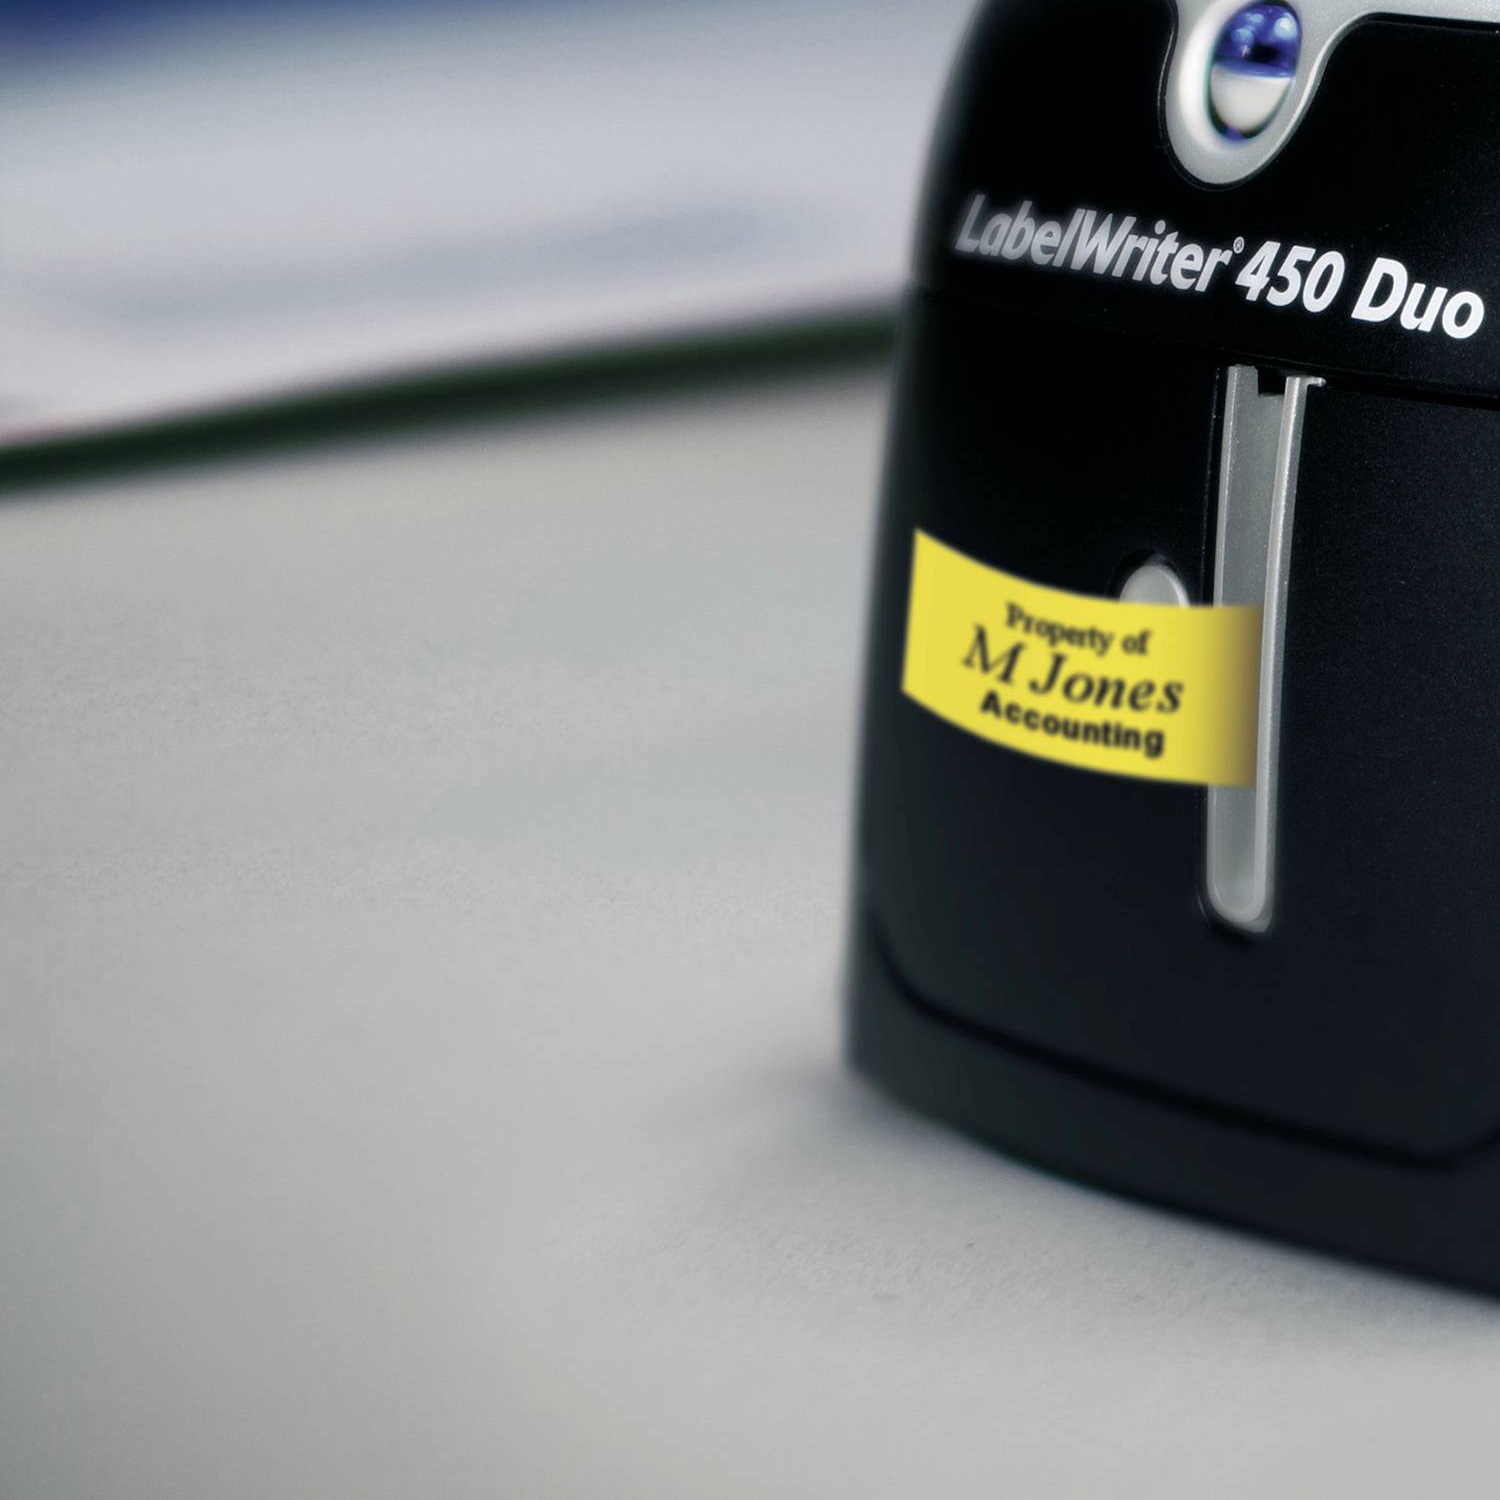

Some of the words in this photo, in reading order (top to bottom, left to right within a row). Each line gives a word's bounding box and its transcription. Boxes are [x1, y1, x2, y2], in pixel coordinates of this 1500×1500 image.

[1234, 240, 1345, 313] 450
[1350, 257, 1485, 340] Duo
[960, 622, 1025, 687] M
[1027, 651, 1186, 715] Jones
[1005, 601, 1114, 657] Property
[1121, 628, 1153, 656] of
[978, 689, 1165, 760] Accounting
